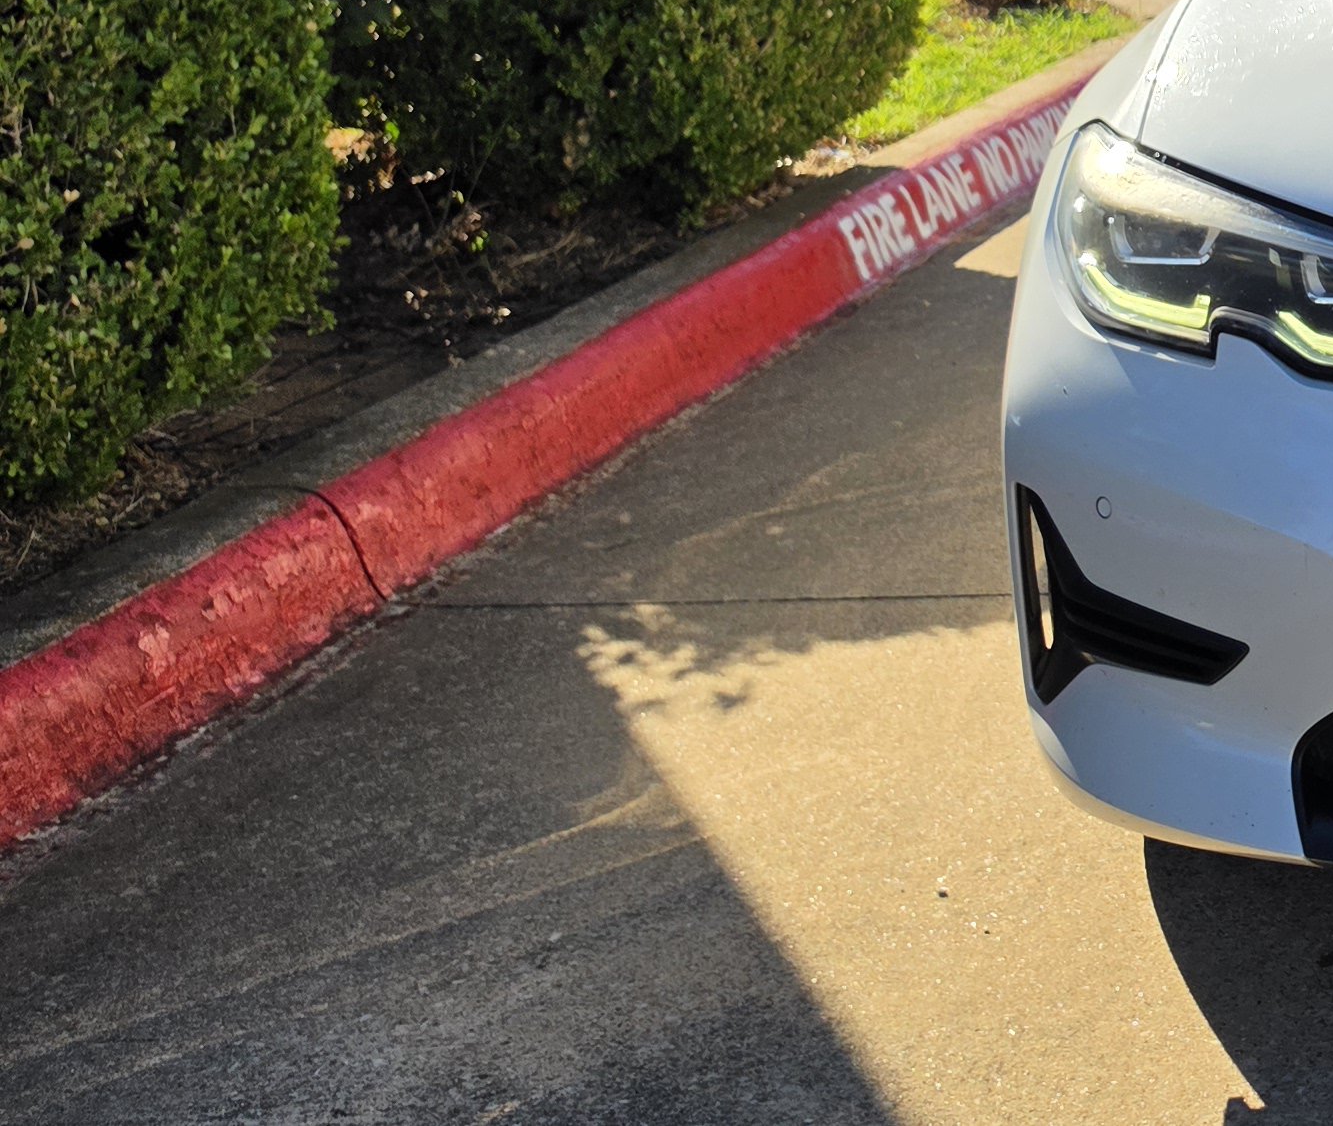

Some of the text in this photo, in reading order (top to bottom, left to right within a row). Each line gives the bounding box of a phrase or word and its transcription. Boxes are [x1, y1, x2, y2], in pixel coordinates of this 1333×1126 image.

[838, 192, 916, 281] FIRE
[898, 153, 982, 239] LANE
[971, 135, 1021, 201] NO
